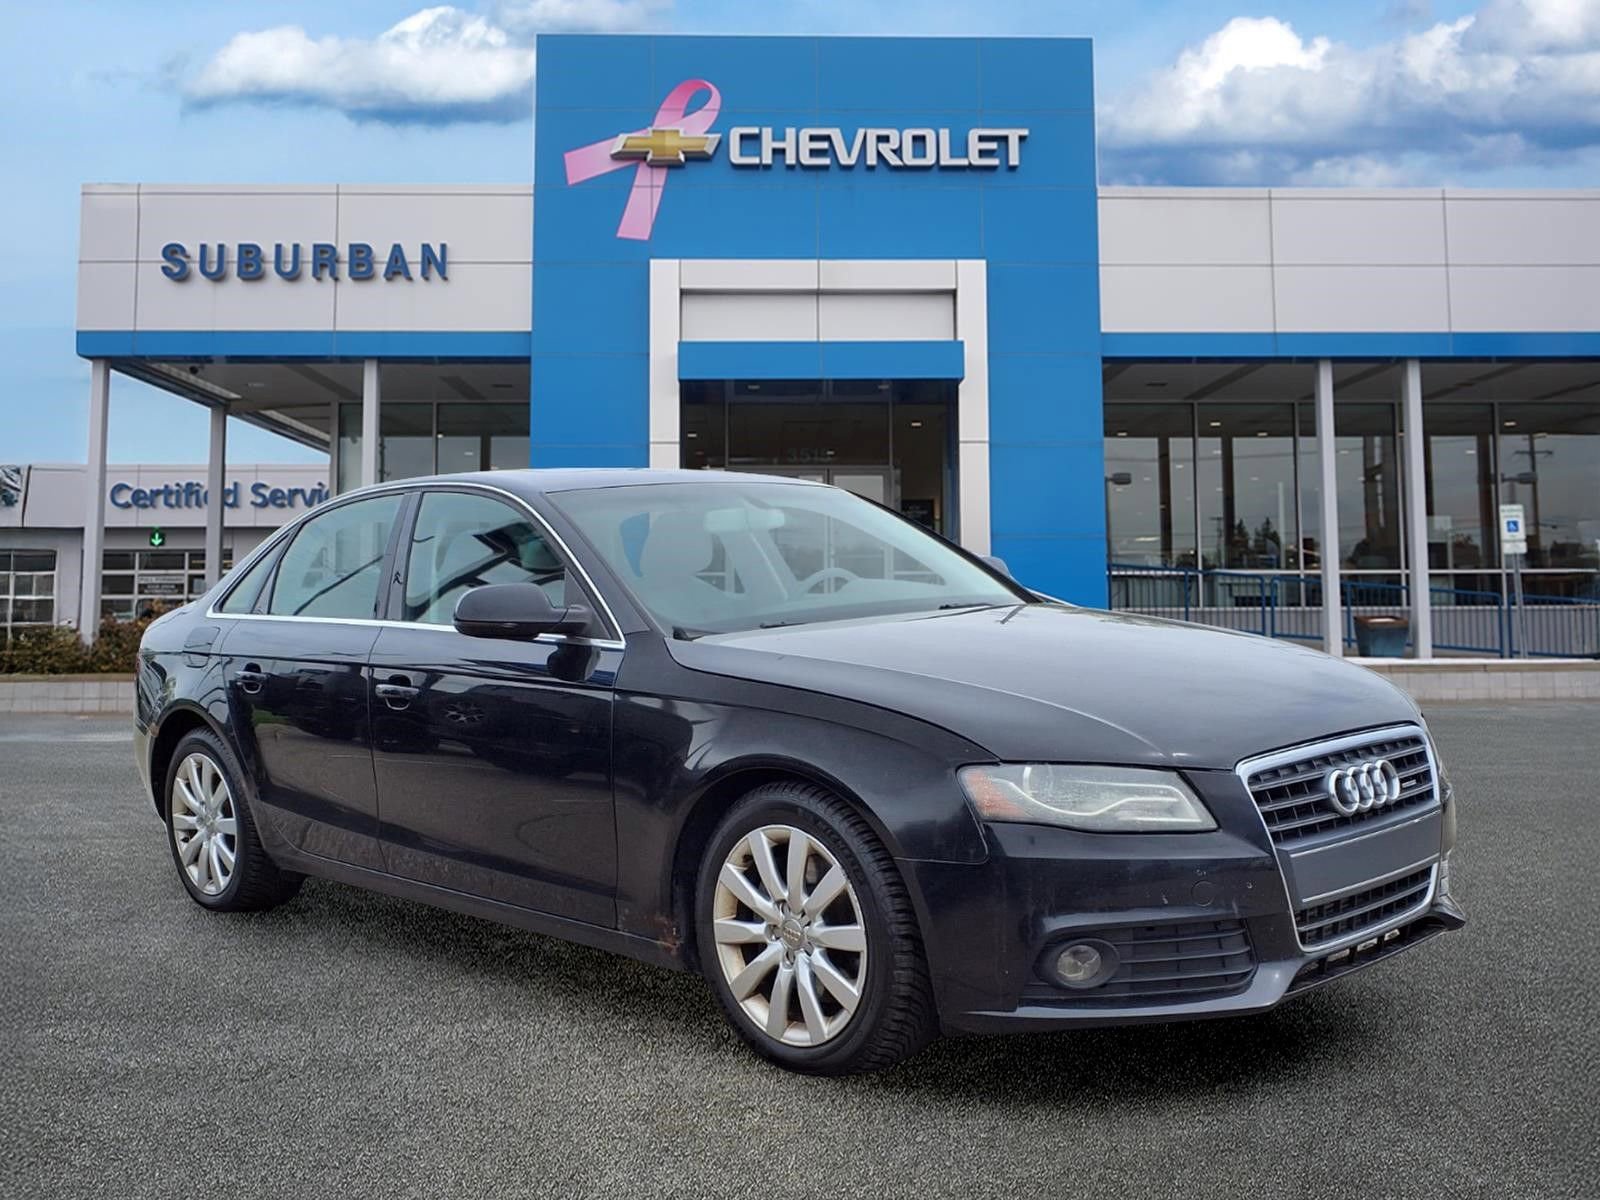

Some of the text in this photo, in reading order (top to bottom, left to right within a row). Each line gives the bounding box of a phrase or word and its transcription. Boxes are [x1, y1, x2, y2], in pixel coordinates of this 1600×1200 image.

[729, 127, 1029, 167] CHEVROLET
[161, 243, 449, 281] SUBURBAN
[110, 481, 239, 508] Certifid
